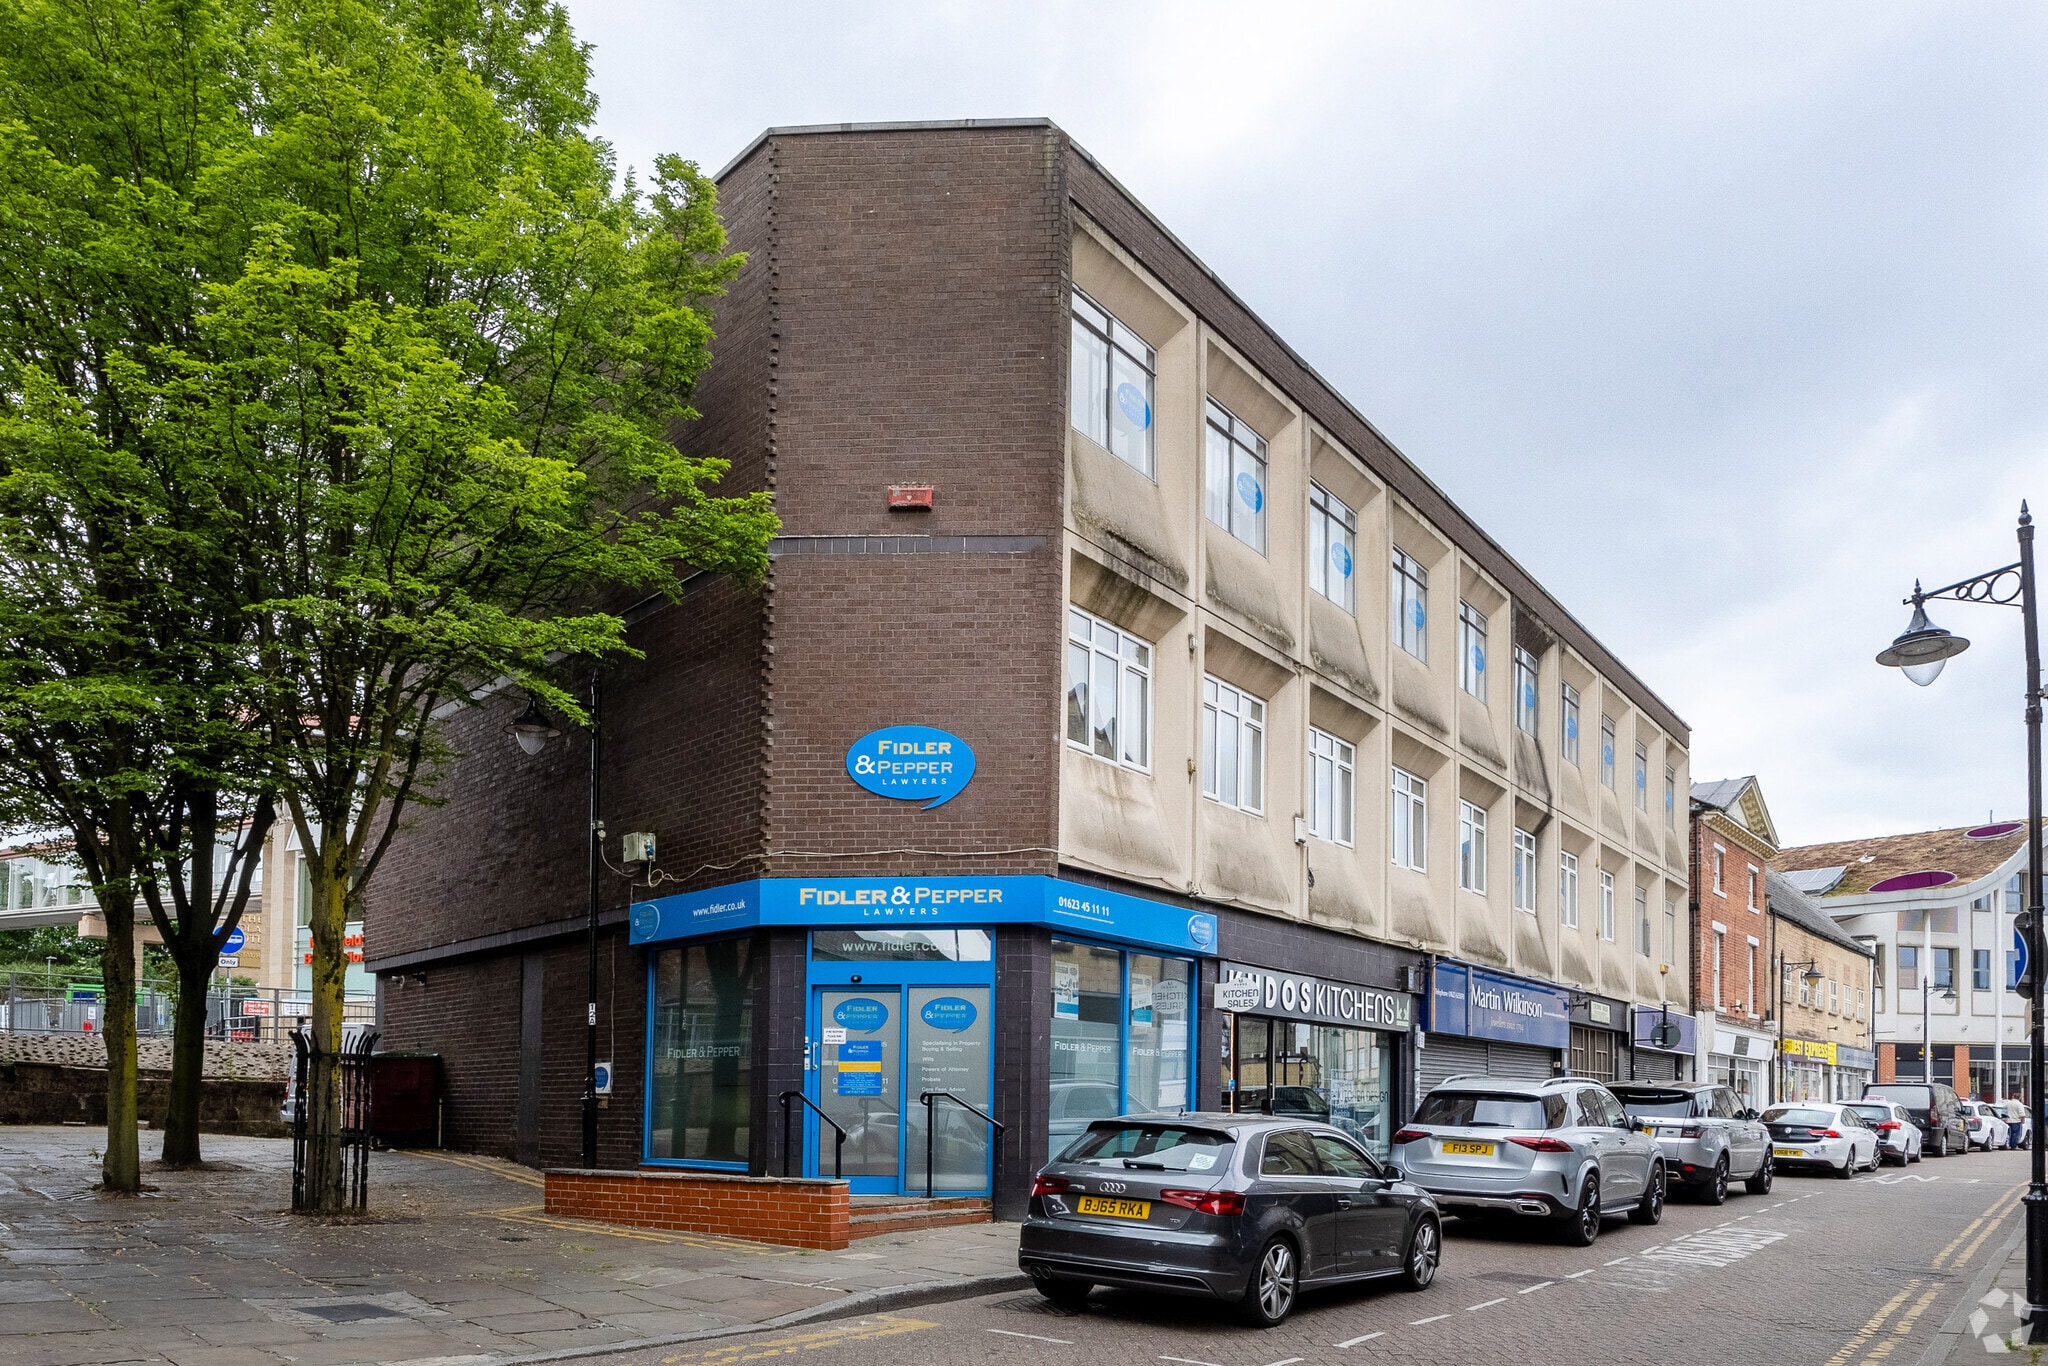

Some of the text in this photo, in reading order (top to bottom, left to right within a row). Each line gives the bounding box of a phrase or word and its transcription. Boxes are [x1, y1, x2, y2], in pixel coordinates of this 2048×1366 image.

[878, 740, 952, 755] FIDLER
[855, 755, 953, 775] & PEPPER
[882, 777, 947, 785] LAWYERS
[799, 885, 1003, 906] FIDLER & PEPPER
[692, 899, 746, 917] www.fidler.co.uk
[863, 907, 939, 916] LAWYERS
[1058, 896, 1110, 917] 01623 45 11 11
[220, 958, 237, 966] Only
[1223, 989, 1259, 998] KITCHEN
[1228, 999, 1254, 1008] SALES
[1471, 984, 1543, 1018] Martin Wilkinson
[837, 1011, 846, 1020] &
[925, 1010, 934, 1019] &
[1315, 984, 1395, 1035] KITCHENS
[667, 1045, 741, 1059] FIDLER & PEPPER
[1054, 1040, 1112, 1054] FIDLER & PEPPER
[1132, 1047, 1155, 1057] FIDLER
[1452, 1143, 1488, 1154] F13 SPJ
[1083, 1199, 1144, 1217] BJ65 RKA
